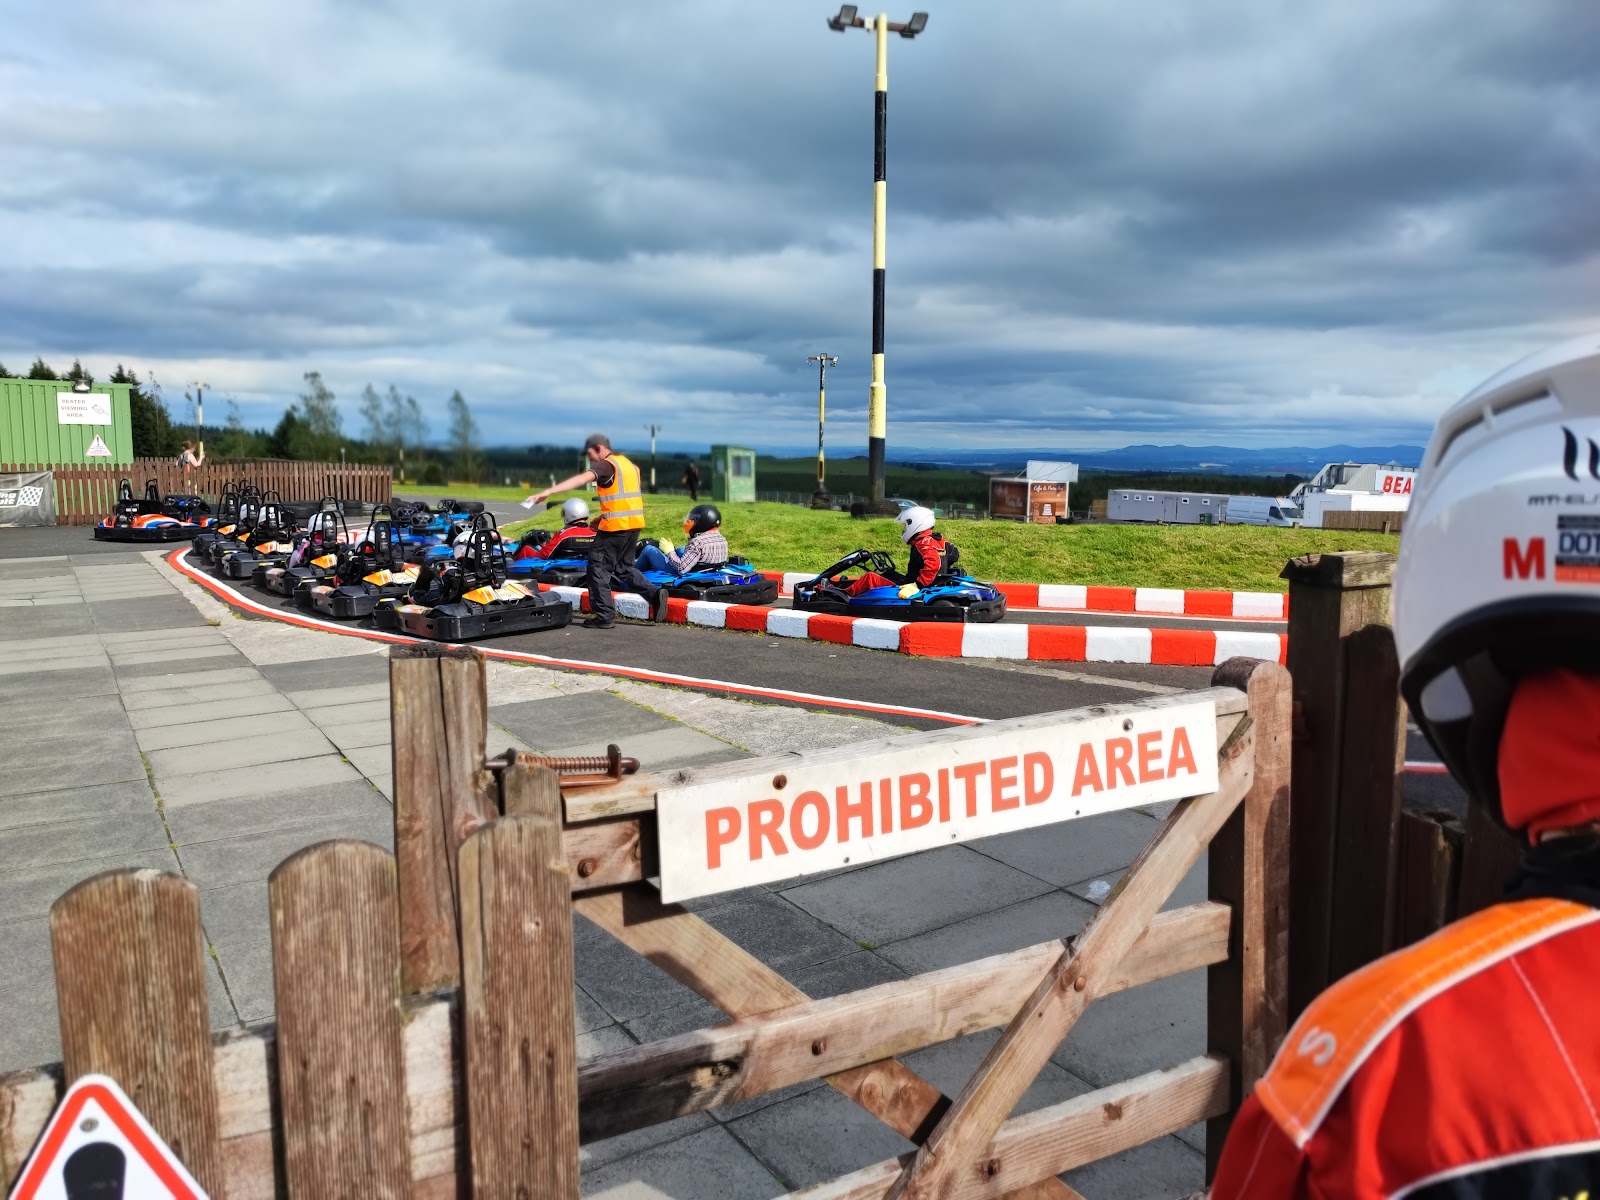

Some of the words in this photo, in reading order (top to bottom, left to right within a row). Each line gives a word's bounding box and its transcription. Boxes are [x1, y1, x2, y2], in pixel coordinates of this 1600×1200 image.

[481, 543, 487, 551] 5
[1502, 537, 1546, 581] M
[704, 751, 1055, 870] PROHIBITED
[1070, 726, 1199, 798] AREA
